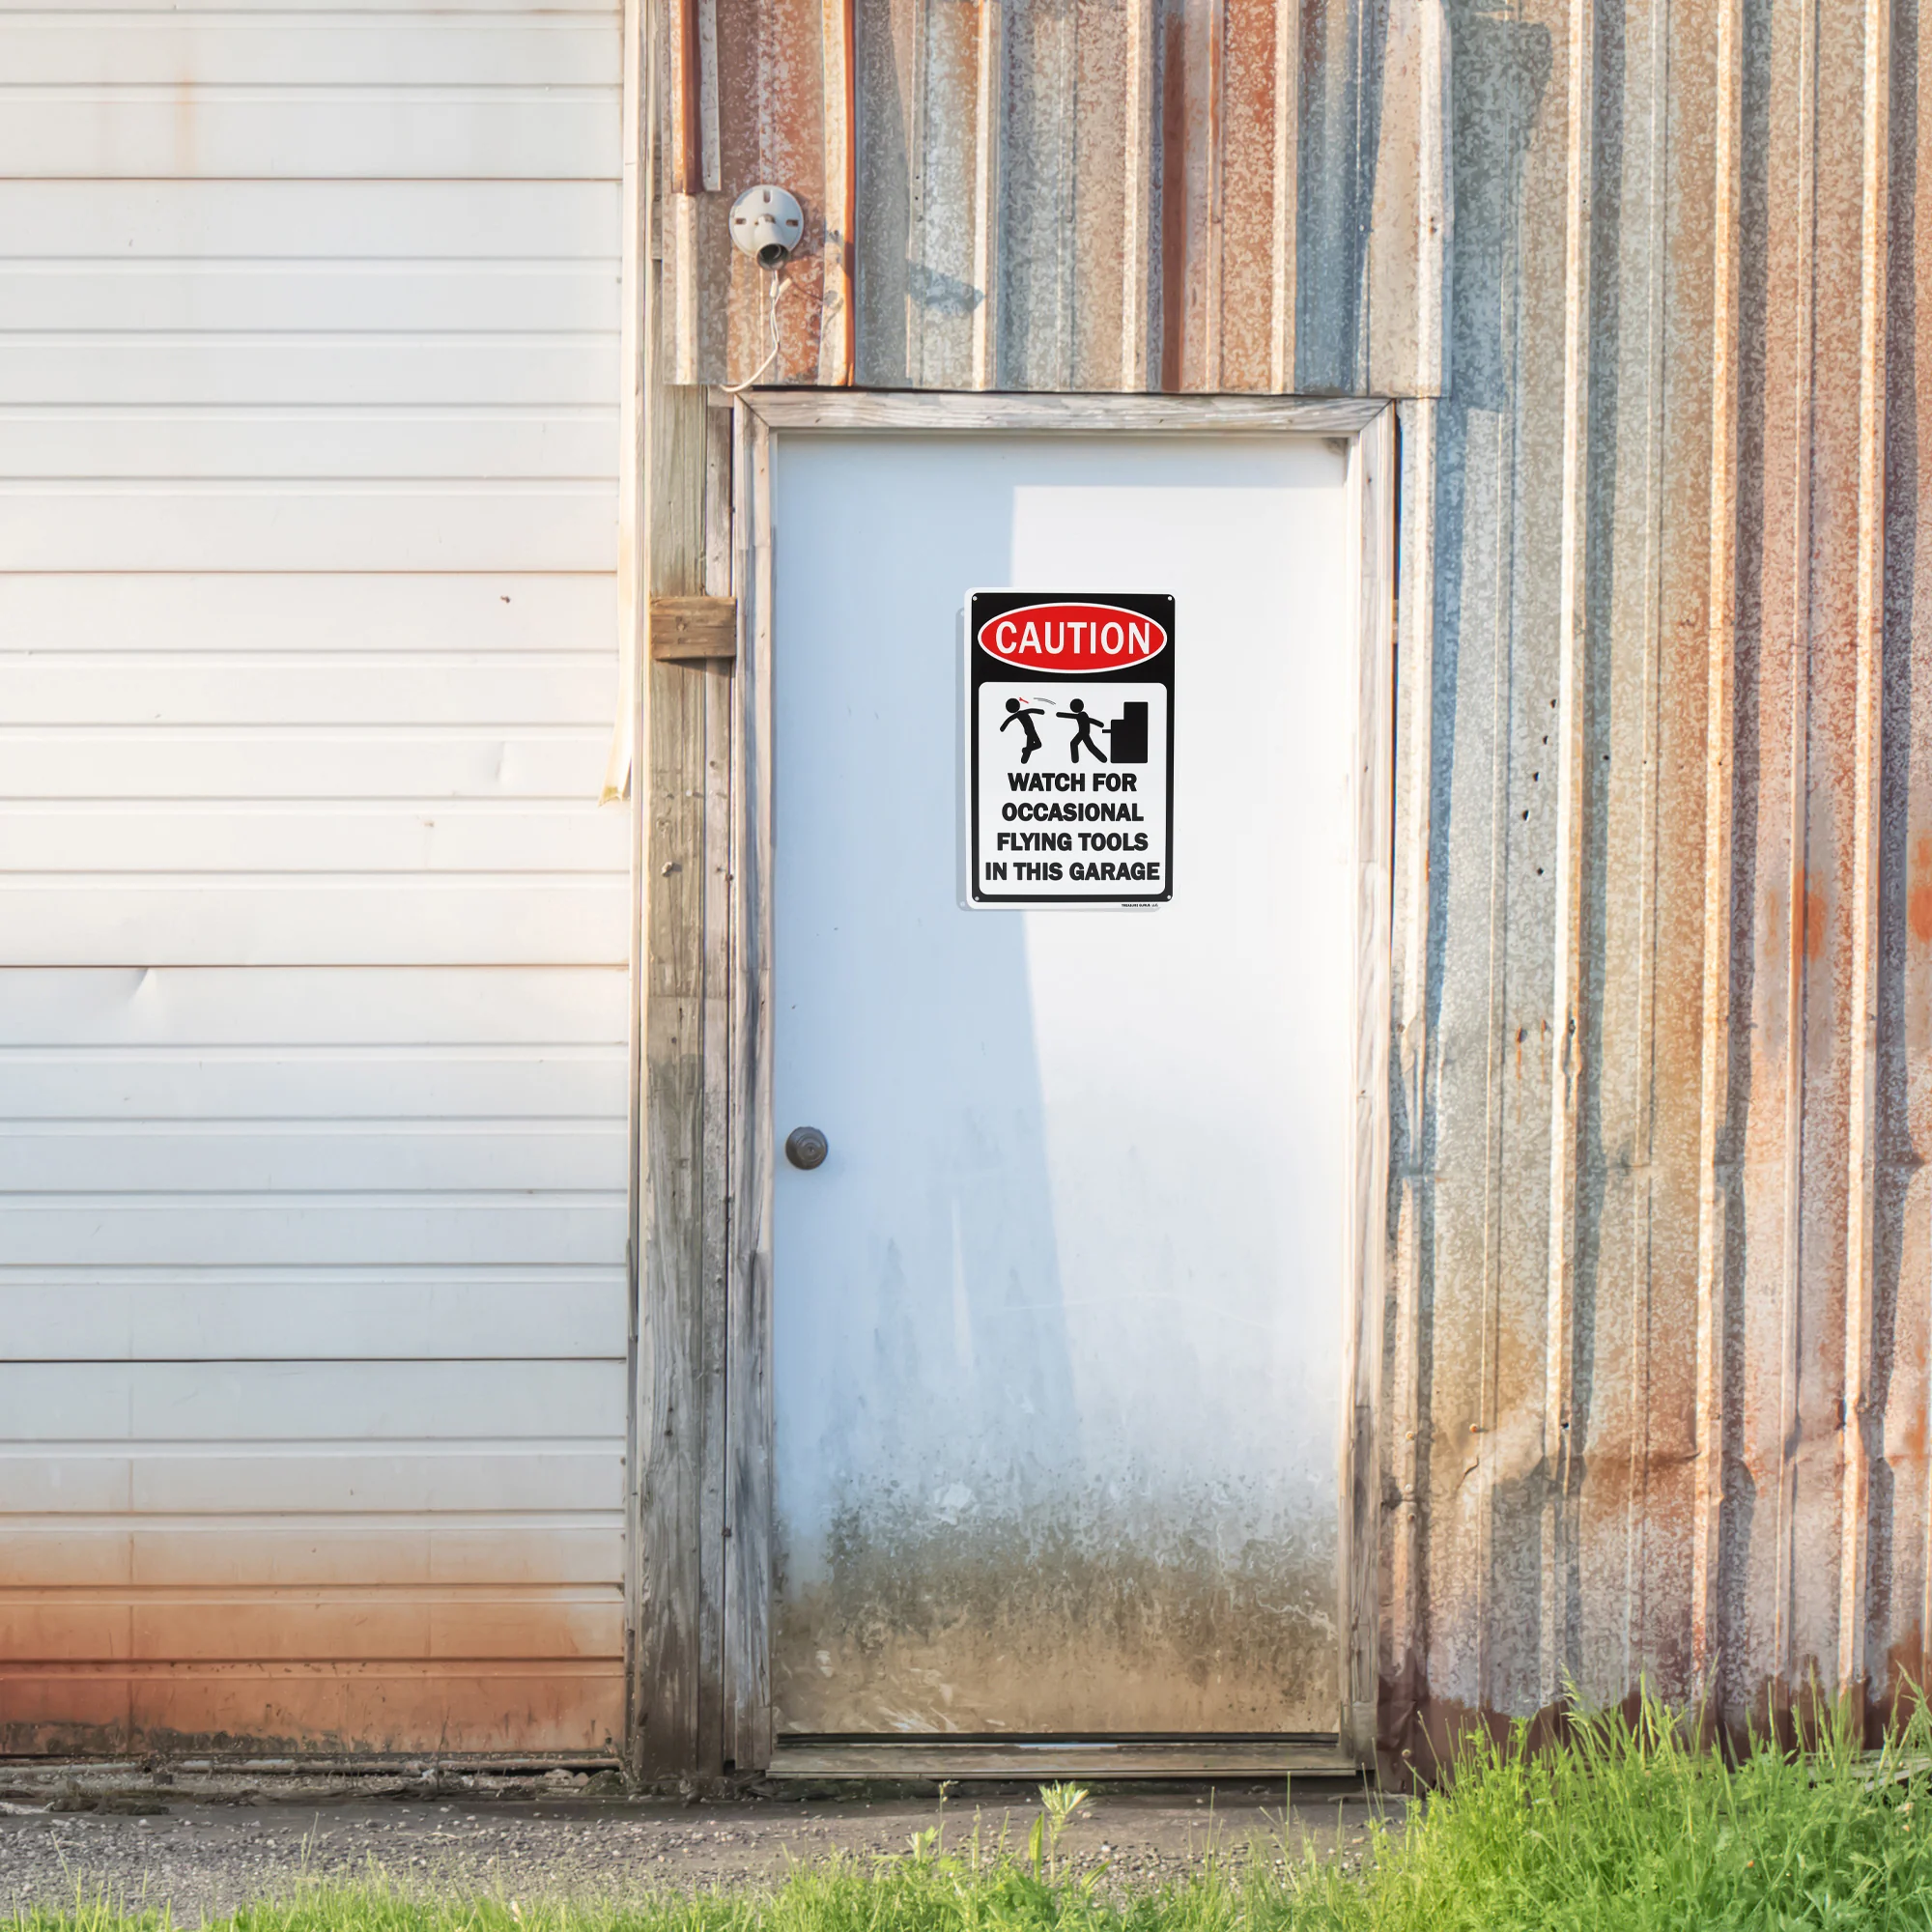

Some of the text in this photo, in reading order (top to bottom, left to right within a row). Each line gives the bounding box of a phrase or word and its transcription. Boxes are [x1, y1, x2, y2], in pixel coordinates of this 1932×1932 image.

[995, 621, 1151, 655] CAUTION
[1008, 773, 1137, 792] WATCH FOR
[1002, 803, 1144, 822] OCCASIONAL
[997, 832, 1149, 851] FLYING TOOLS
[985, 862, 1160, 881] IN THIS GARAGE
